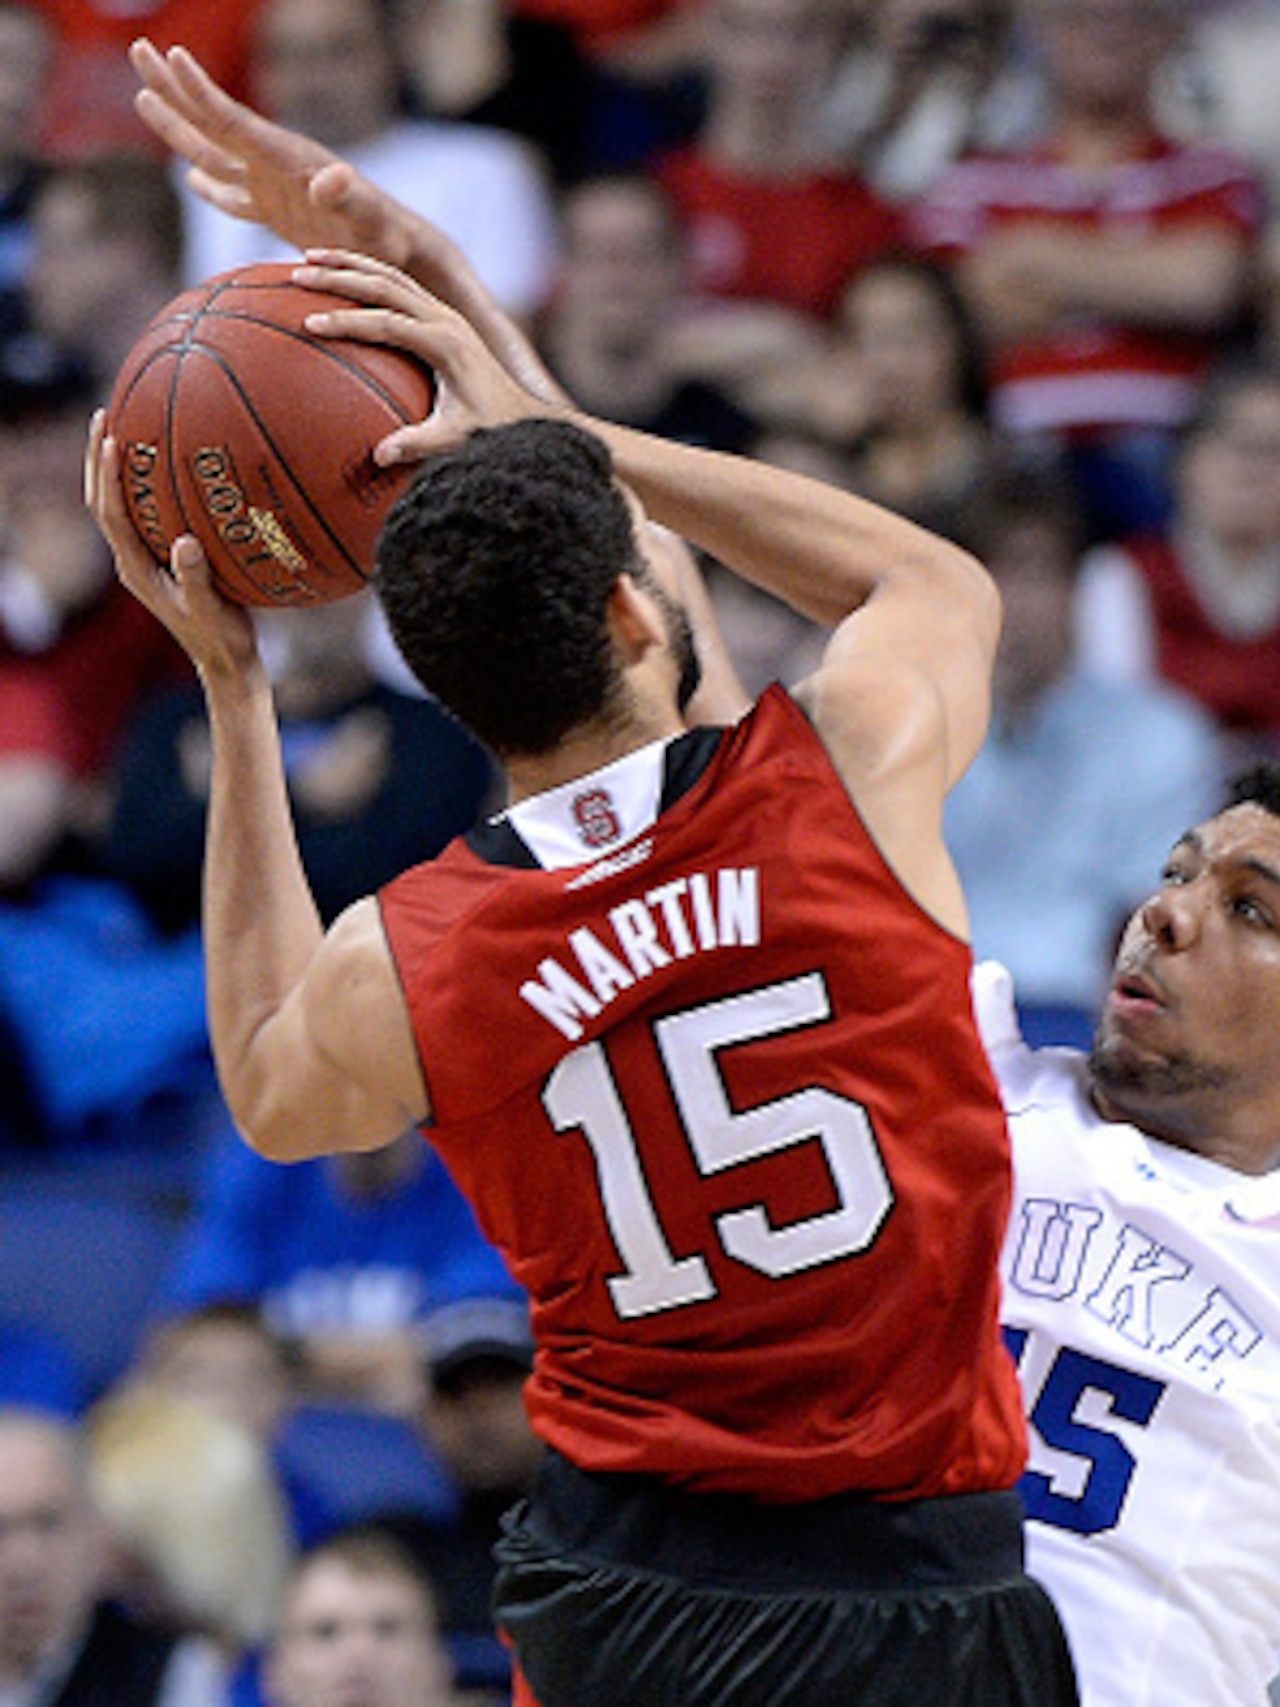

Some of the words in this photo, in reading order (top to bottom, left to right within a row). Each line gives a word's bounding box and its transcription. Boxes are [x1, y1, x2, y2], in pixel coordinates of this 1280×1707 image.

[519, 867, 758, 1041] MARTIN
[540, 970, 895, 1321] 15
[1009, 1198, 1264, 1391] UKE
[999, 1324, 1168, 1538] 5
